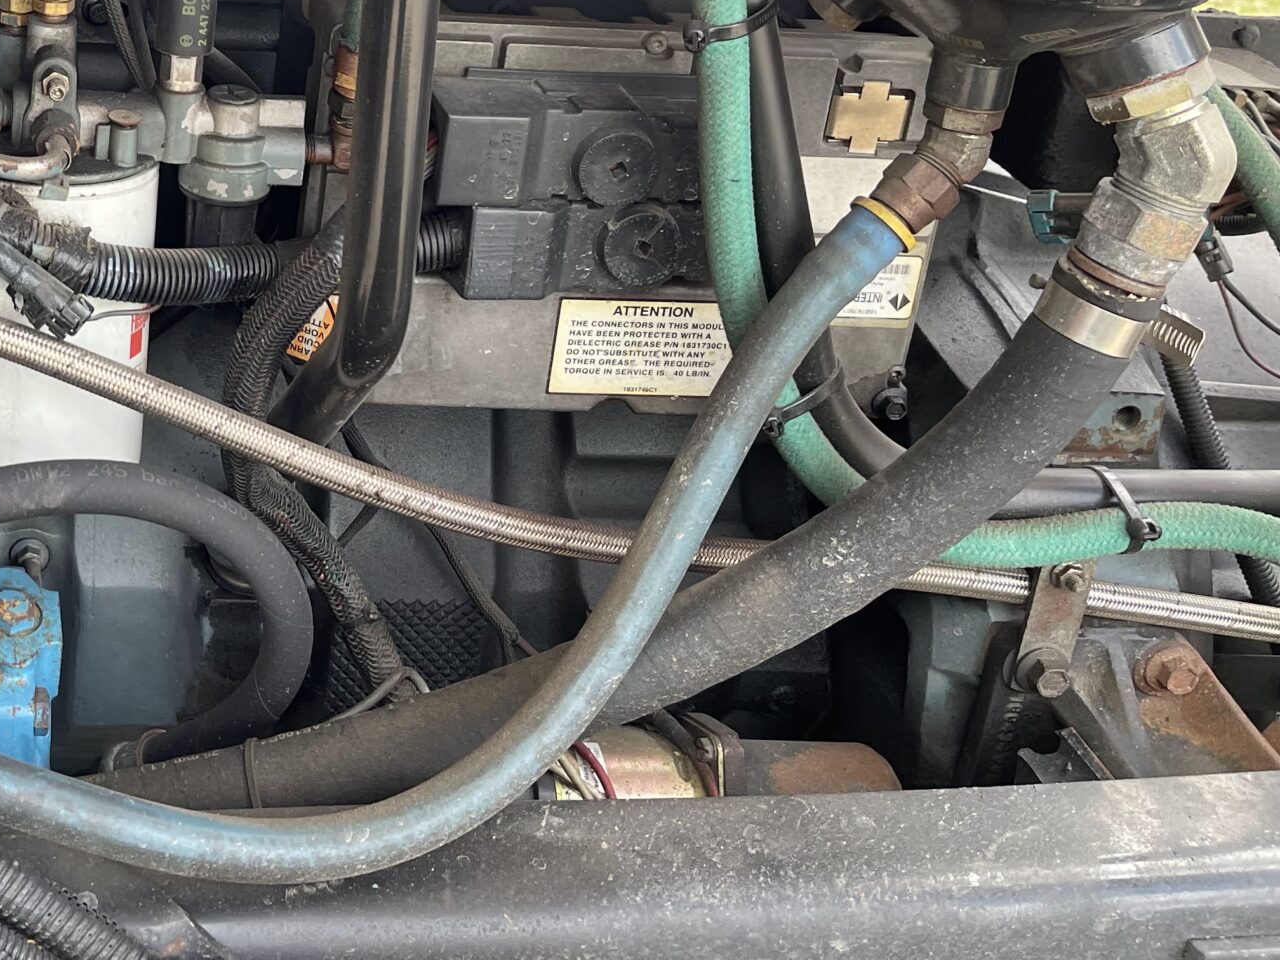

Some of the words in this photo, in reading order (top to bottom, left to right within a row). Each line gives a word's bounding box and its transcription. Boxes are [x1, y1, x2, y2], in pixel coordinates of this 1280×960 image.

[199, 15, 209, 36] 447
[198, 39, 207, 47] 2
[853, 293, 883, 303] INTER
[613, 306, 694, 318] ATTENTION
[312, 318, 330, 330] ATT
[571, 320, 589, 328] THE
[591, 320, 654, 329] CONNECTORS
[691, 323, 725, 331] MODUL
[304, 326, 325, 339] VOR
[569, 329, 594, 337] HAVE
[596, 330, 621, 338] BEEN
[623, 331, 678, 339] PROTECTED
[681, 332, 703, 340] WITH
[705, 332, 712, 340] A
[297, 335, 320, 348] CUID
[567, 339, 621, 347] DIELECTRIC
[624, 340, 661, 348] GREASE
[290, 343, 311, 355] ARN
[566, 348, 580, 356] DO
[603, 349, 660, 358] SUBSTITUTE
[564, 357, 596, 365] OTHER
[664, 360, 711, 368] REQUIRED
[564, 367, 600, 375] TORQUE
[615, 368, 654, 376] SERVICE
[87, 463, 128, 479] 245
